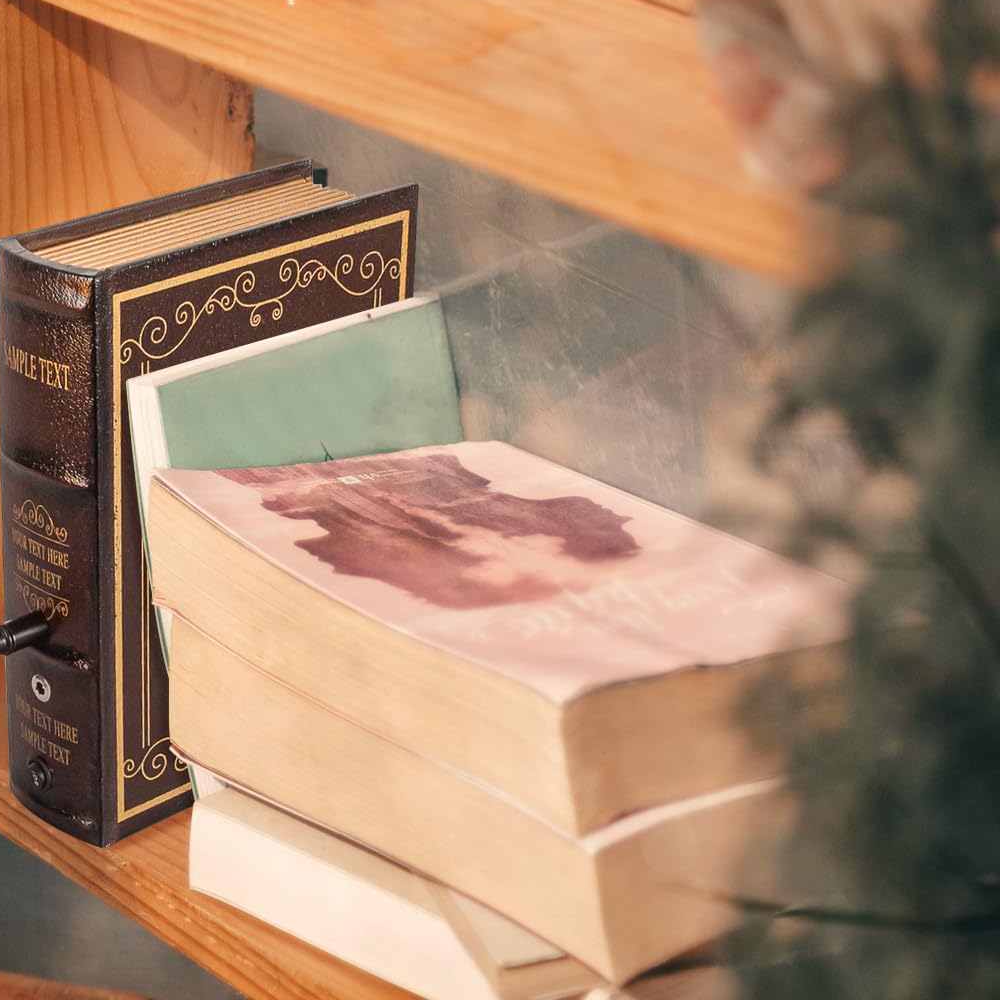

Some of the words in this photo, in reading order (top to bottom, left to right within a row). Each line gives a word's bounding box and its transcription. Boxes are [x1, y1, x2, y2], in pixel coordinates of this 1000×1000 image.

[38, 357, 70, 391] TEXT
[28, 537, 46, 560] TEXT
[47, 547, 70, 569] HERE
[41, 568, 63, 591] TEXT
[32, 707, 53, 733] TEXT
[54, 720, 79, 744] HERE
[48, 741, 71, 766] TEXT
